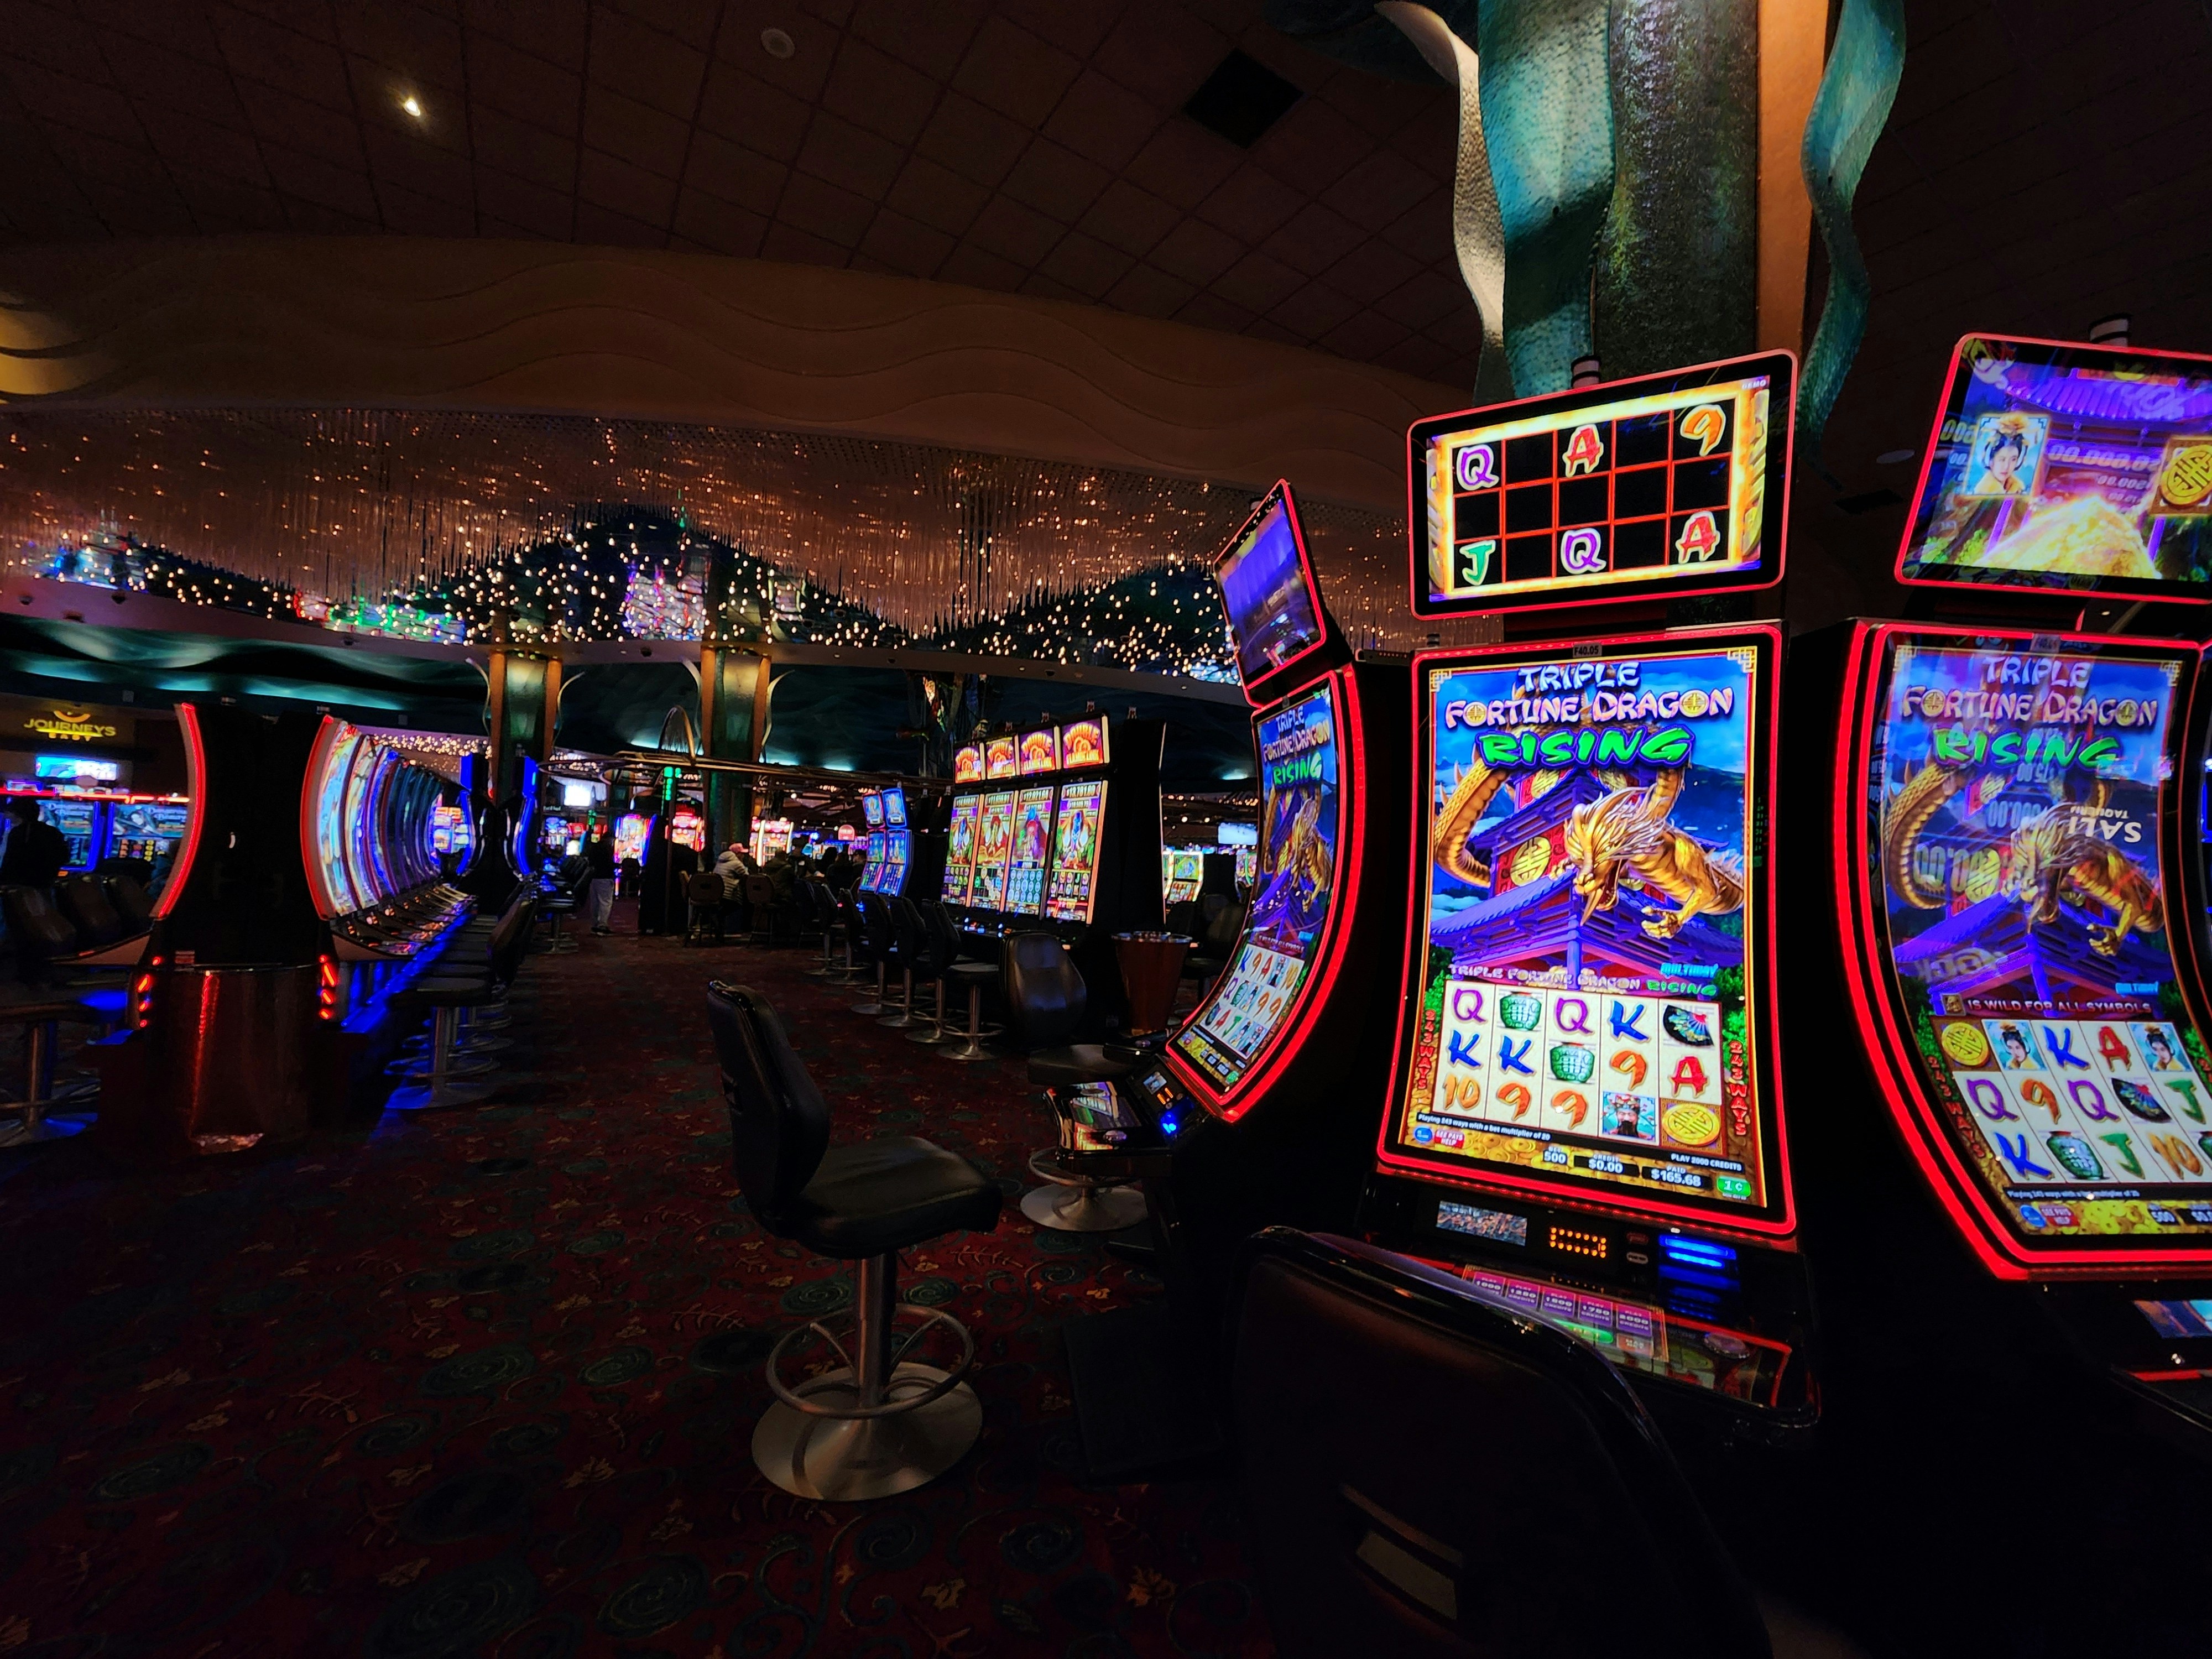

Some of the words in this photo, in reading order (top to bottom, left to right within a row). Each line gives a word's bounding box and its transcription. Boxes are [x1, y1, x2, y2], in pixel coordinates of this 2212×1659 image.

[1681, 404, 1726, 456] 9
[1563, 424, 1603, 477] A
[1457, 444, 1499, 491] Q
[1561, 528, 1606, 573] Q
[1676, 511, 1720, 564] A
[1459, 540, 1495, 585] J
[1519, 662, 1640, 692] TRIPLE
[1983, 656, 2091, 688] TRIPLE
[1276, 706, 1303, 732] TRIPLE
[1446, 696, 1579, 728] FORTUNE
[1592, 687, 1733, 722] DRAGON
[1903, 685, 2033, 721] FORTUNE
[2043, 691, 2157, 727] DRAGON
[24, 719, 116, 736] JOURNEYS
[1063, 722, 1100, 750] DOUBLE
[1262, 735, 1294, 761] FORTUNE
[1295, 721, 1331, 751] DRAGON
[1021, 731, 1053, 758] DOUBLE
[1479, 727, 1692, 764] RISING
[1933, 728, 2120, 767] RISING
[1273, 752, 1322, 786] RISING
[1249, 952, 1262, 978] 9
[1256, 954, 1274, 982] A
[1449, 964, 1504, 979] TRIPLE
[1507, 968, 1574, 985] FORTUNE
[1578, 973, 1641, 990] DRAGON
[1647, 980, 1717, 995] RISING
[1253, 992, 1270, 1018] 9
[1265, 997, 1282, 1024] 9
[1453, 988, 1488, 1024] Q
[1554, 997, 1595, 1036] Q
[1609, 999, 1651, 1042] K
[1968, 1000, 1981, 1010] IS
[1984, 1000, 2022, 1011] WILD
[2025, 1000, 2053, 1011] FOR
[2058, 1001, 2080, 1012] ALL
[2086, 1002, 2152, 1013] SYMBOLS
[1210, 1009, 1231, 1032] A
[1222, 1015, 1243, 1039] J
[1425, 1010, 1436, 1044] 243
[1447, 1029, 1483, 1070] K
[1497, 1035, 1535, 1076] K
[1610, 1049, 1648, 1091] 9
[1669, 1055, 1709, 1098] A
[1729, 1040, 1744, 1081] 243
[2043, 1025, 2091, 1070] K
[2098, 1025, 2131, 1072] A
[1418, 1046, 1434, 1090] WAYS
[1443, 1074, 1480, 1110] 10
[1496, 1081, 1532, 1121] 9
[1551, 1089, 1589, 1129] 9
[1729, 1084, 1749, 1136] WAYS
[1927, 1055, 1953, 1098] 243
[1945, 1102, 1985, 1158] WAYS
[1966, 1078, 2020, 1123] Q
[2020, 1078, 2062, 1125] 9
[2068, 1078, 2121, 1123] Q
[2164, 1079, 2206, 1125] J
[1418, 1114, 1439, 1124] Playing
[1441, 1117, 1453, 1125] 243
[1489, 1125, 1500, 1133] bet
[1501, 1127, 1532, 1139] multiplier
[1441, 1137, 1457, 1146] HELP
[1448, 1132, 1463, 1141] PAYS
[1544, 1151, 1566, 1164] 500
[1588, 1159, 1623, 1173] $0.00
[1593, 1154, 1619, 1163] CREDIT
[1666, 1165, 1686, 1175] PAID
[1671, 1153, 1691, 1163] PLAY
[1691, 1157, 1709, 1167] 2000
[1710, 1160, 1743, 1172] CREDITS
[1994, 1131, 2056, 1181] K
[2099, 1133, 2146, 1180] J
[2149, 1131, 2204, 1180] 10
[1651, 1170, 1702, 1188] $165.68
[1509, 1293, 1536, 1303] CREDITS
[1544, 1302, 1572, 1312] CREDITS
[1580, 1311, 1610, 1321] CREDITS
[1619, 1320, 1650, 1331] CREDITS
